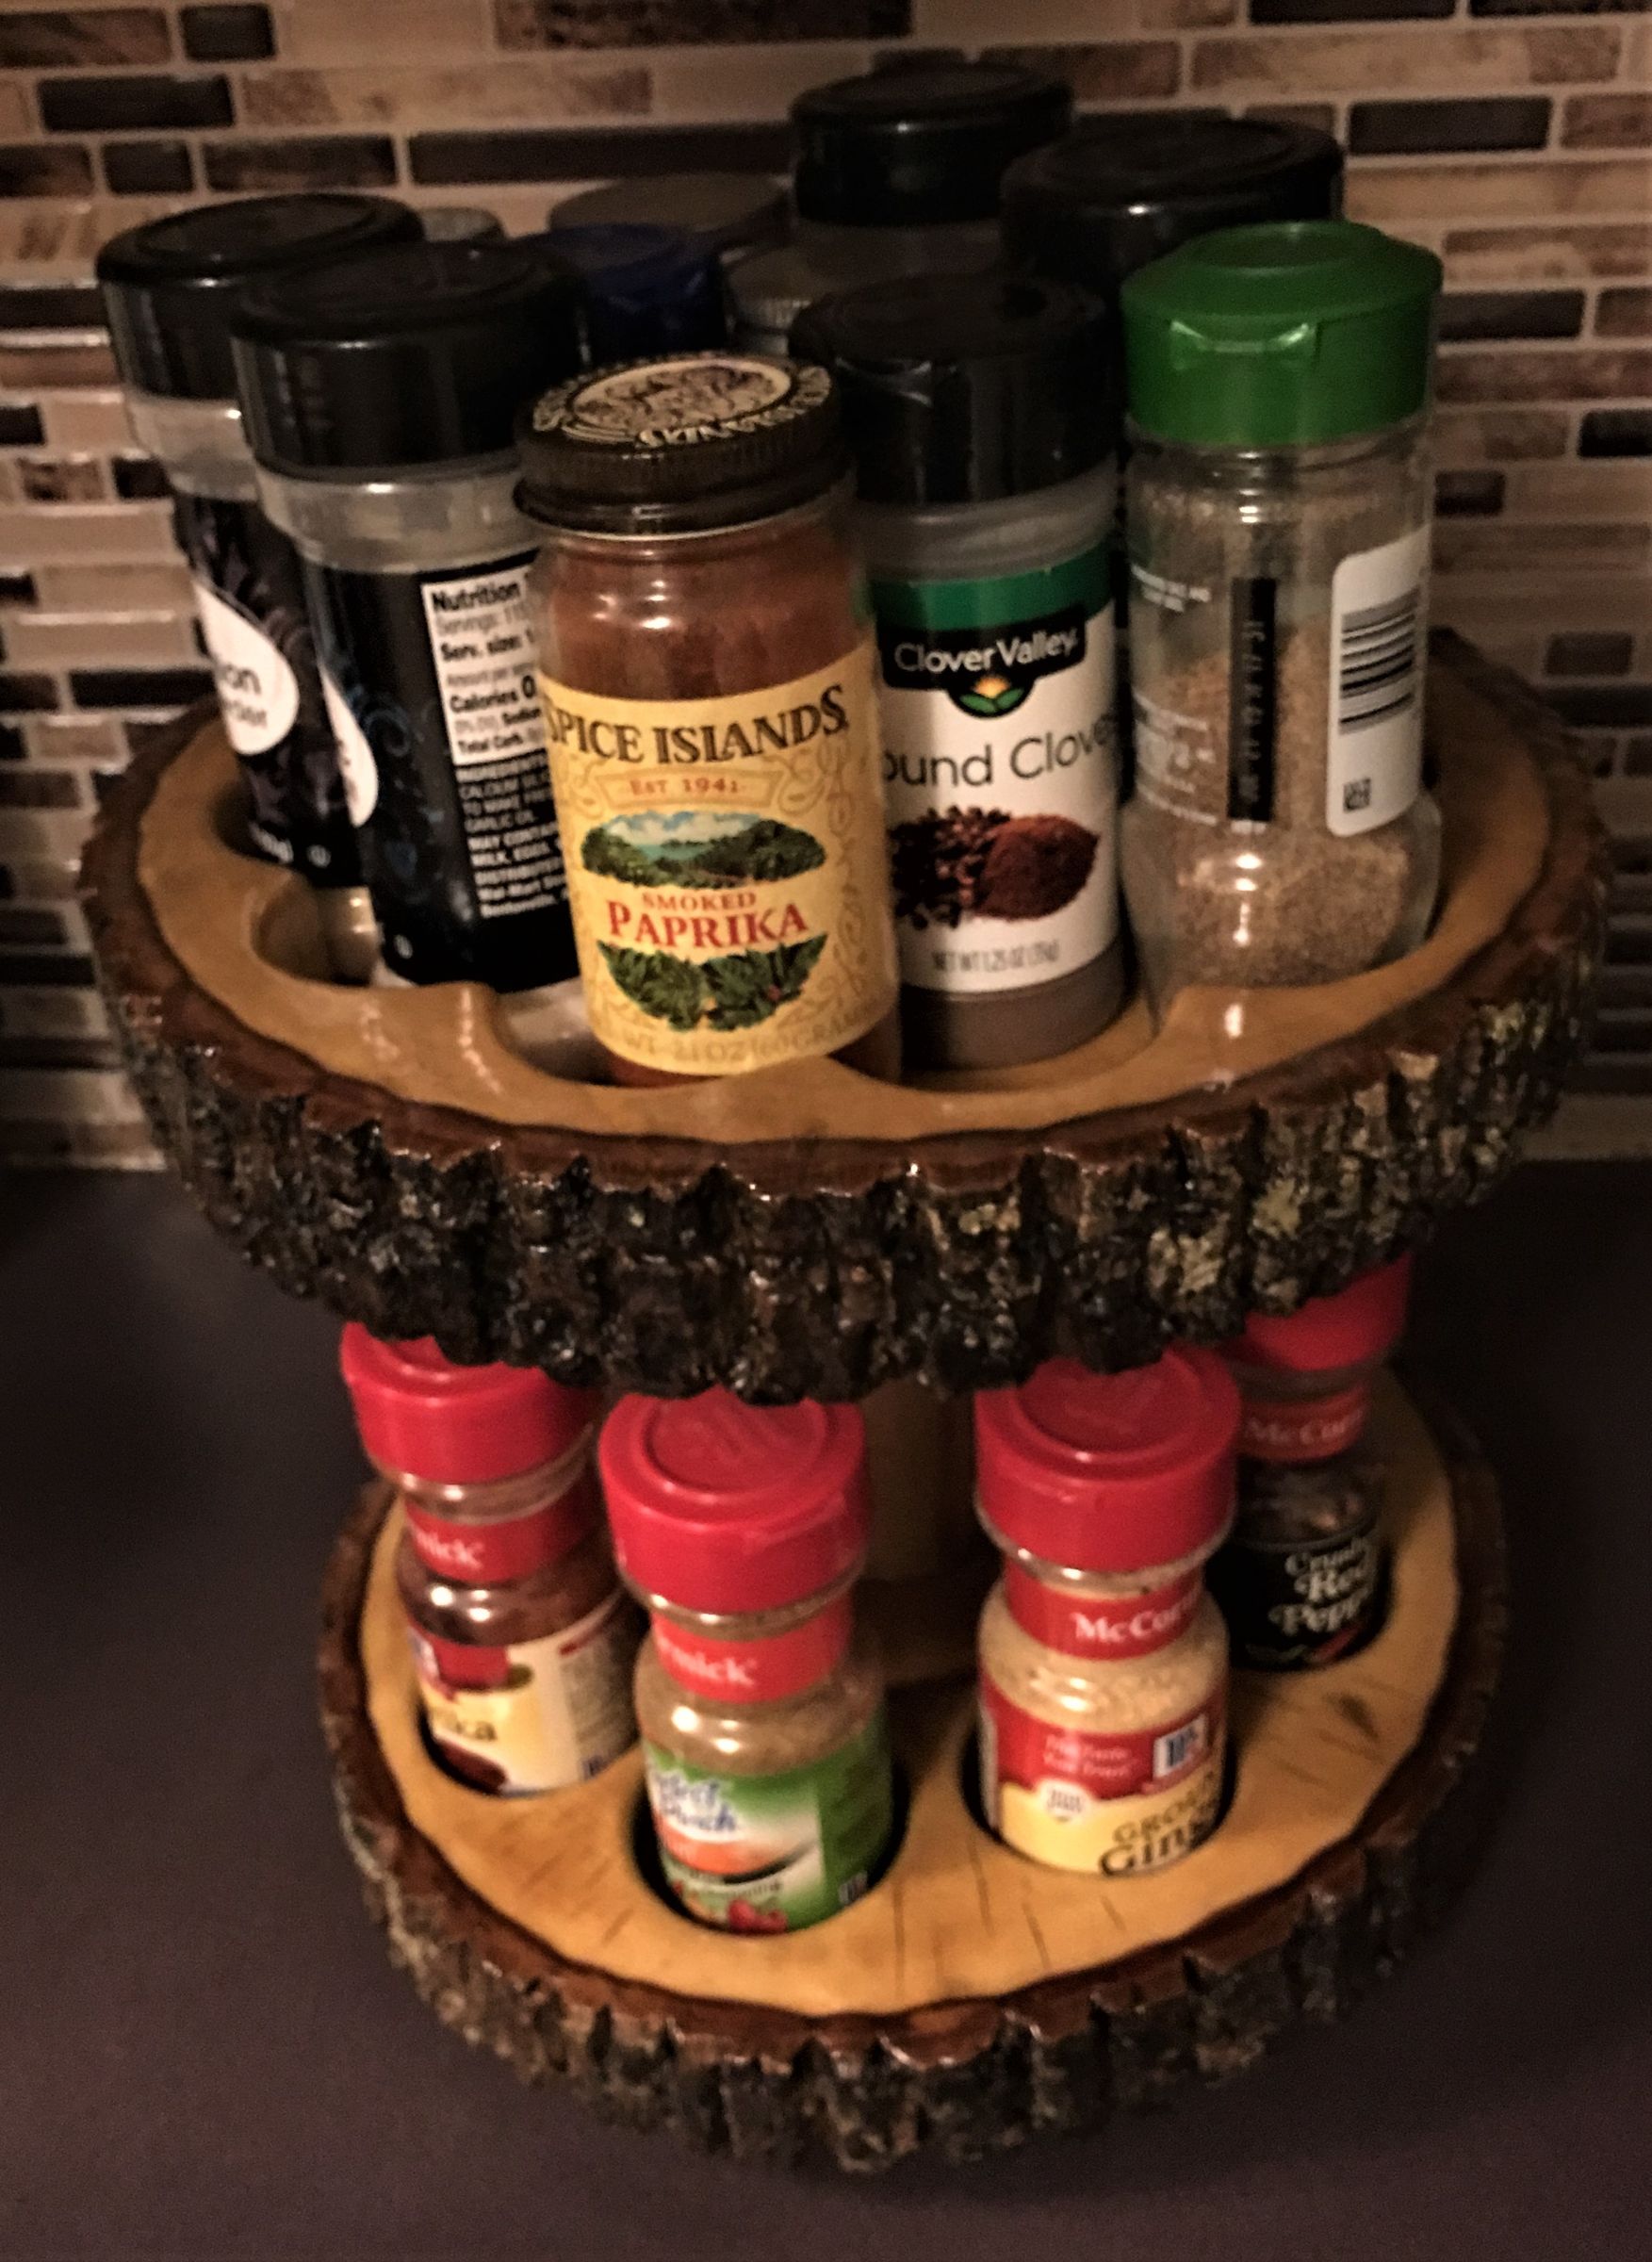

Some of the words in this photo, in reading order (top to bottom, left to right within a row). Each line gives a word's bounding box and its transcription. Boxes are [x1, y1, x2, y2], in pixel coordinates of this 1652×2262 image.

[431, 582, 521, 613] Nutrition
[893, 641, 994, 673] Clover
[995, 625, 1078, 667] Valley
[450, 690, 518, 713] Calories
[652, 682, 850, 765] ISLANDS
[883, 743, 993, 788] ound
[1009, 710, 1120, 780] Clove
[606, 899, 810, 948] PAPRIKA
[642, 892, 758, 912] SMOKED
